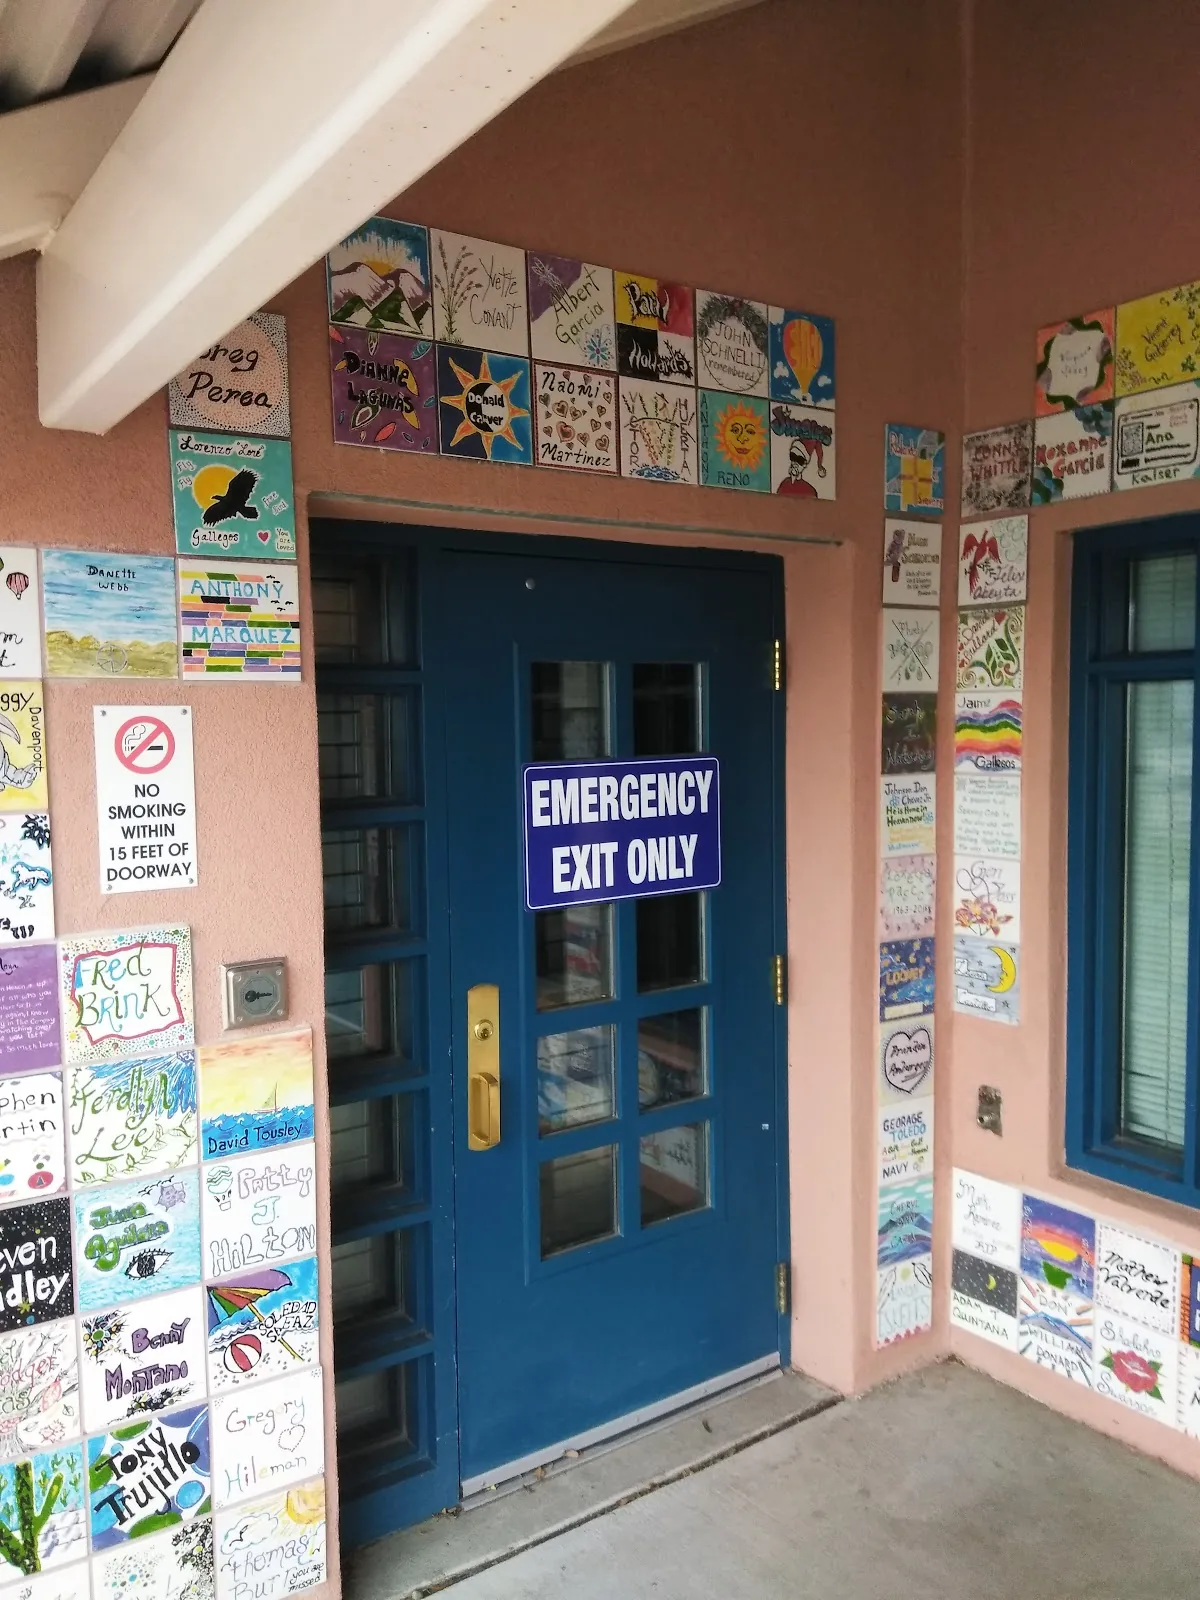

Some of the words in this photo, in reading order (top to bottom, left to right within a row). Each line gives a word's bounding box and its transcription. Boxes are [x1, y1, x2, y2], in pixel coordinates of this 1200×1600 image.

[479, 255, 519, 302] Yvette
[552, 266, 601, 323] Albert
[555, 301, 604, 345] Garcia
[714, 321, 751, 347] JOHN
[702, 337, 764, 369] SCHNELLI
[187, 371, 272, 408] Perea
[541, 371, 601, 399] Naomi
[468, 391, 506, 409] Donald
[180, 436, 233, 455] Lorenzo
[700, 393, 710, 484] ANTHONY
[1145, 432, 1175, 445] Ana
[541, 442, 612, 467] Martinez
[1053, 451, 1106, 479] Garcia
[717, 472, 750, 487] RENO
[192, 529, 239, 548] Gallegos
[190, 579, 284, 598] ANTHONY
[192, 626, 295, 644] MARQUEZ
[27, 706, 44, 773] Davenport
[134, 784, 160, 798] NO
[531, 770, 713, 827] EMERGENCY
[108, 803, 186, 820] SMOKING
[120, 823, 175, 839] WITHIN
[110, 847, 127, 861] 15
[132, 844, 164, 859] FEET
[168, 843, 189, 856] OF
[552, 842, 618, 893] EXIT
[627, 834, 698, 885] ONLY
[106, 862, 192, 882] DOORWAY
[75, 1127, 153, 1165] Lee
[208, 1129, 249, 1154] David
[253, 1121, 303, 1141] Tousley
[889, 1124, 926, 1142] TOLEDO
[883, 1161, 908, 1178] NAVY
[1100, 1267, 1169, 1309] Valverde
[953, 1292, 983, 1313] ADAM
[258, 1302, 317, 1336] SOLEDAD
[953, 1306, 1009, 1340] QUINTANA
[226, 1396, 305, 1435] Gregory
[94, 1441, 200, 1525] Trujillo
[225, 1456, 307, 1498] Hileman
[288, 1571, 321, 1592] missed
[289, 1567, 309, 1585] you
